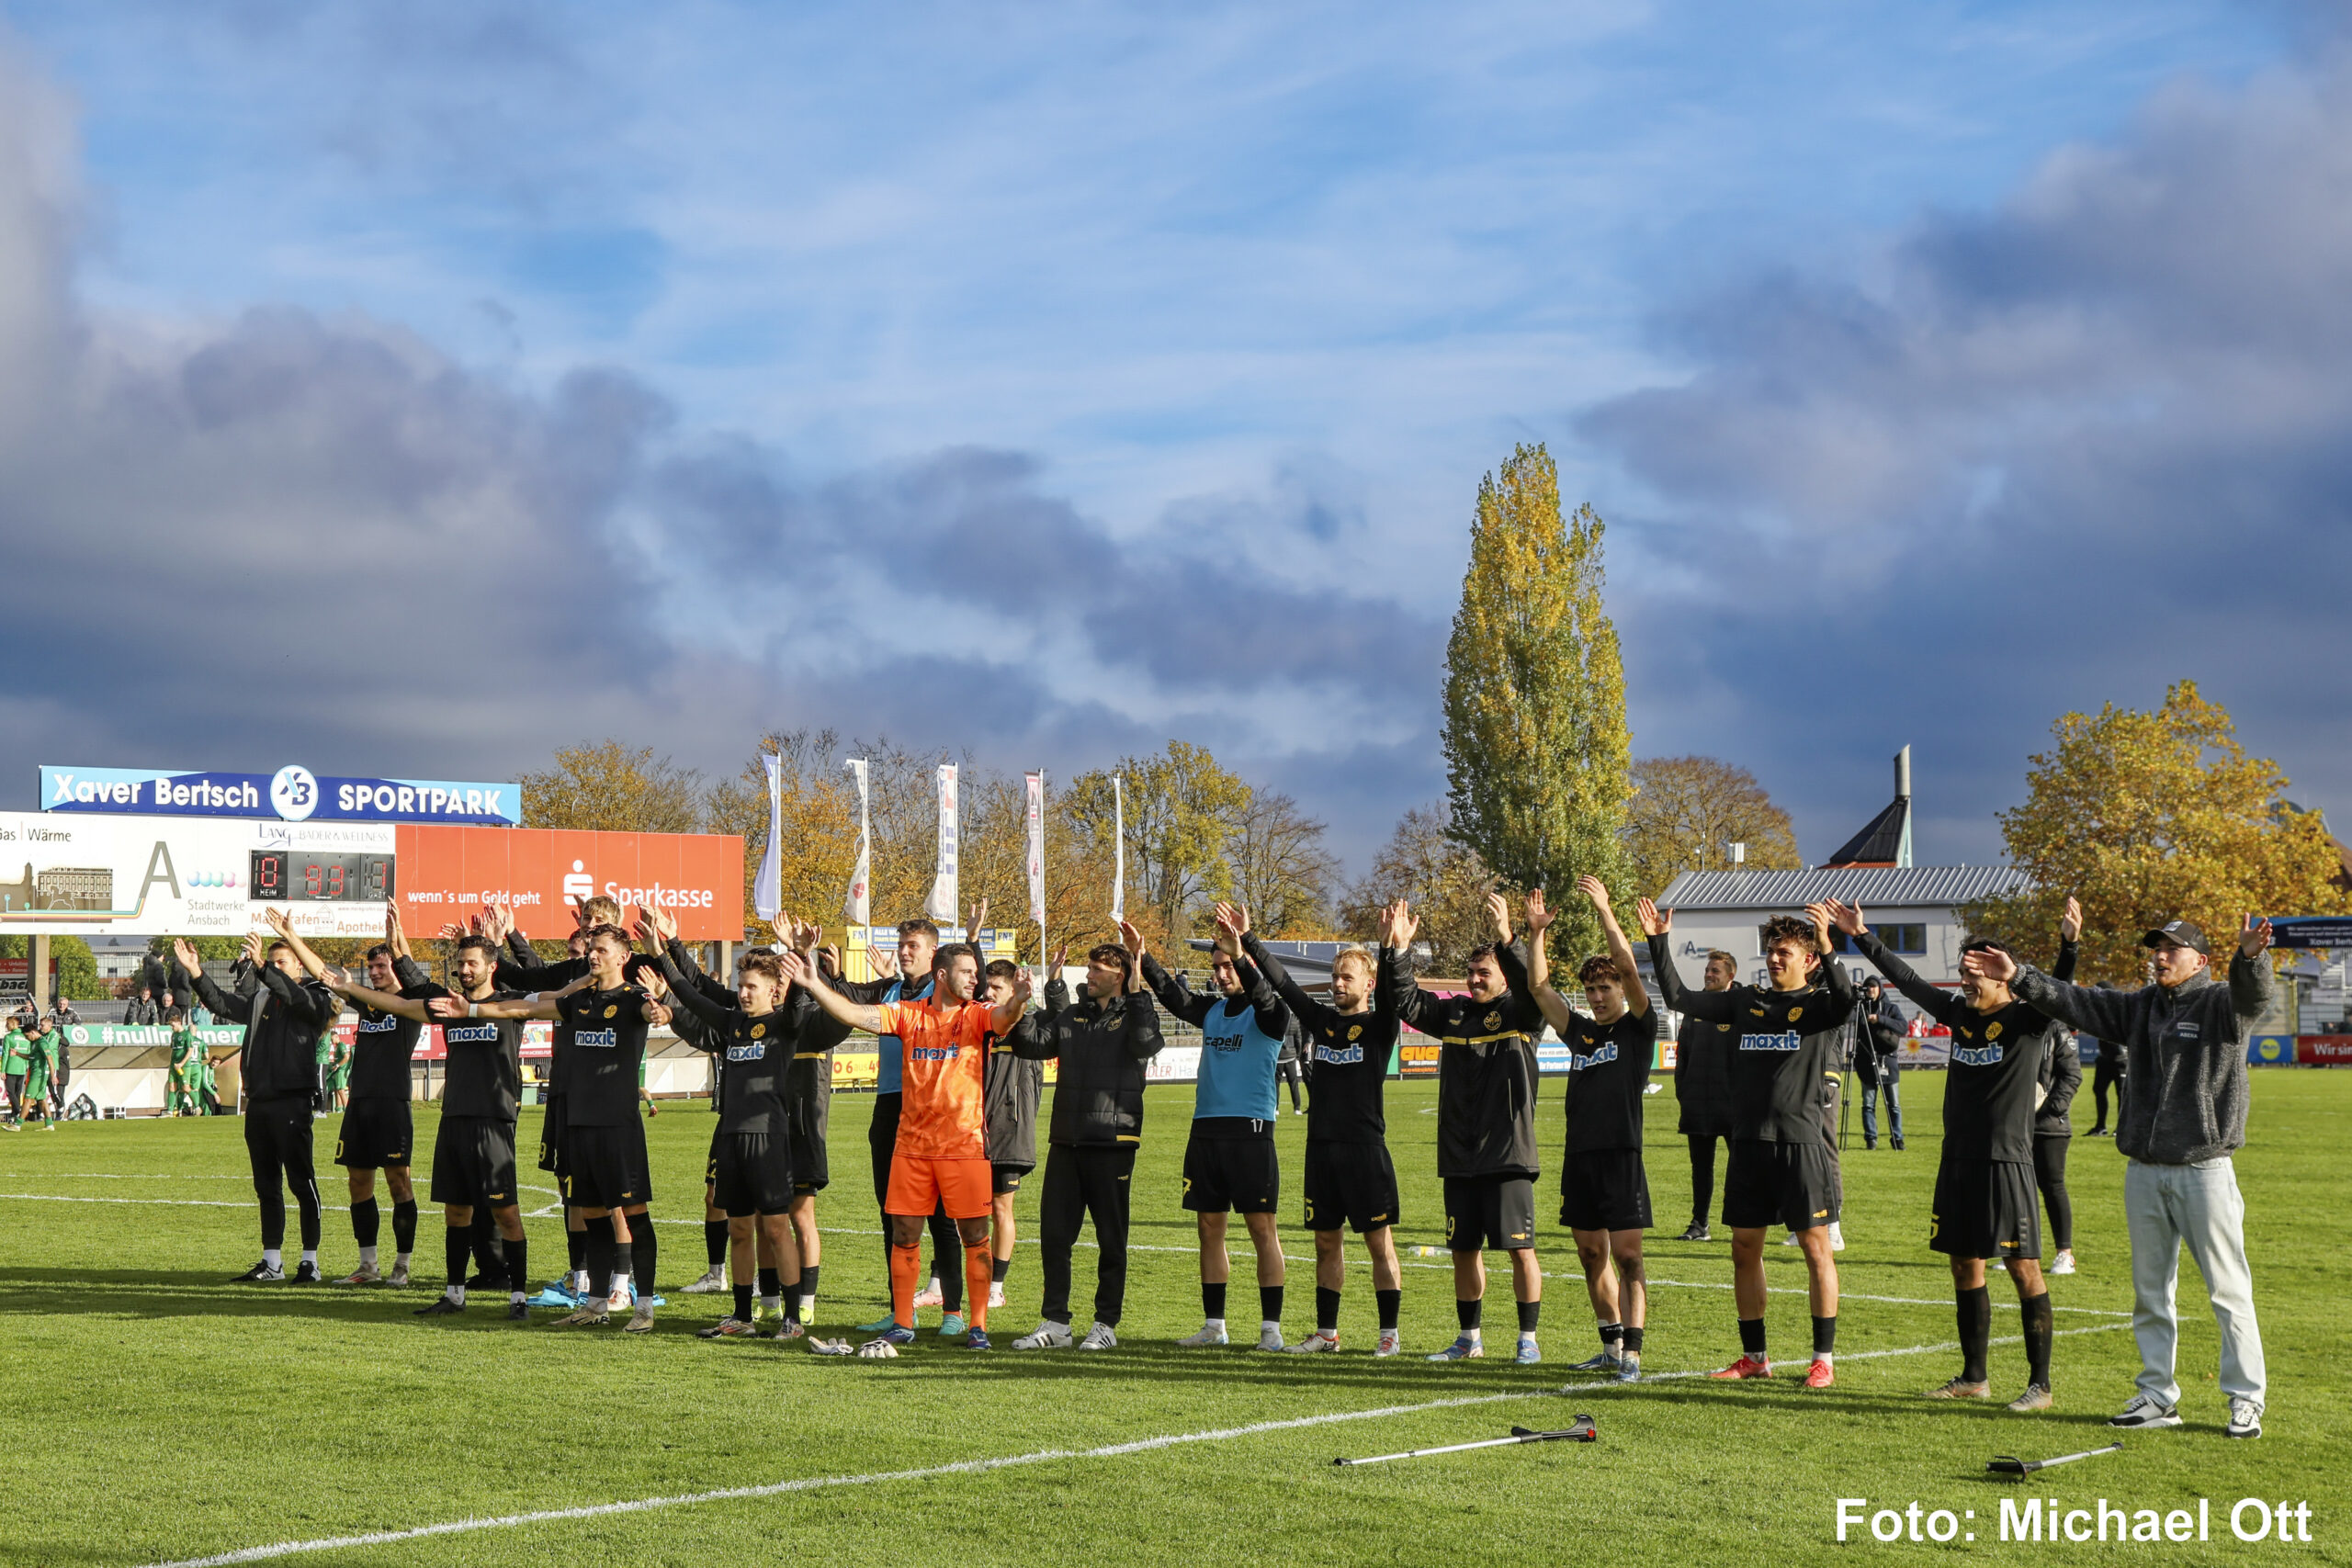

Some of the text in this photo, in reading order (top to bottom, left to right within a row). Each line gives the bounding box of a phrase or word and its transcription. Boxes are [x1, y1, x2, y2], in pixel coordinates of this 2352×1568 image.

[53, 773, 141, 804] Xaver
[154, 778, 258, 808] Bertsch
[338, 784, 502, 816] SPORTPARK
[28, 828, 72, 842] Wärme
[458, 892, 478, 904] um
[513, 890, 541, 908] geht
[605, 882, 713, 908] Sparkasse
[187, 898, 245, 911] Stadtwerke
[187, 914, 230, 926] Ansbach
[251, 912, 321, 925] Marafen
[337, 920, 385, 934] Apothek
[447, 1022, 498, 1043] maxit
[575, 1028, 616, 1047] maxit
[1205, 1033, 1244, 1049] capelli
[1740, 1029, 1801, 1051] maxit
[911, 1042, 959, 1061] maxit
[1250, 1118, 1264, 1133] 17
